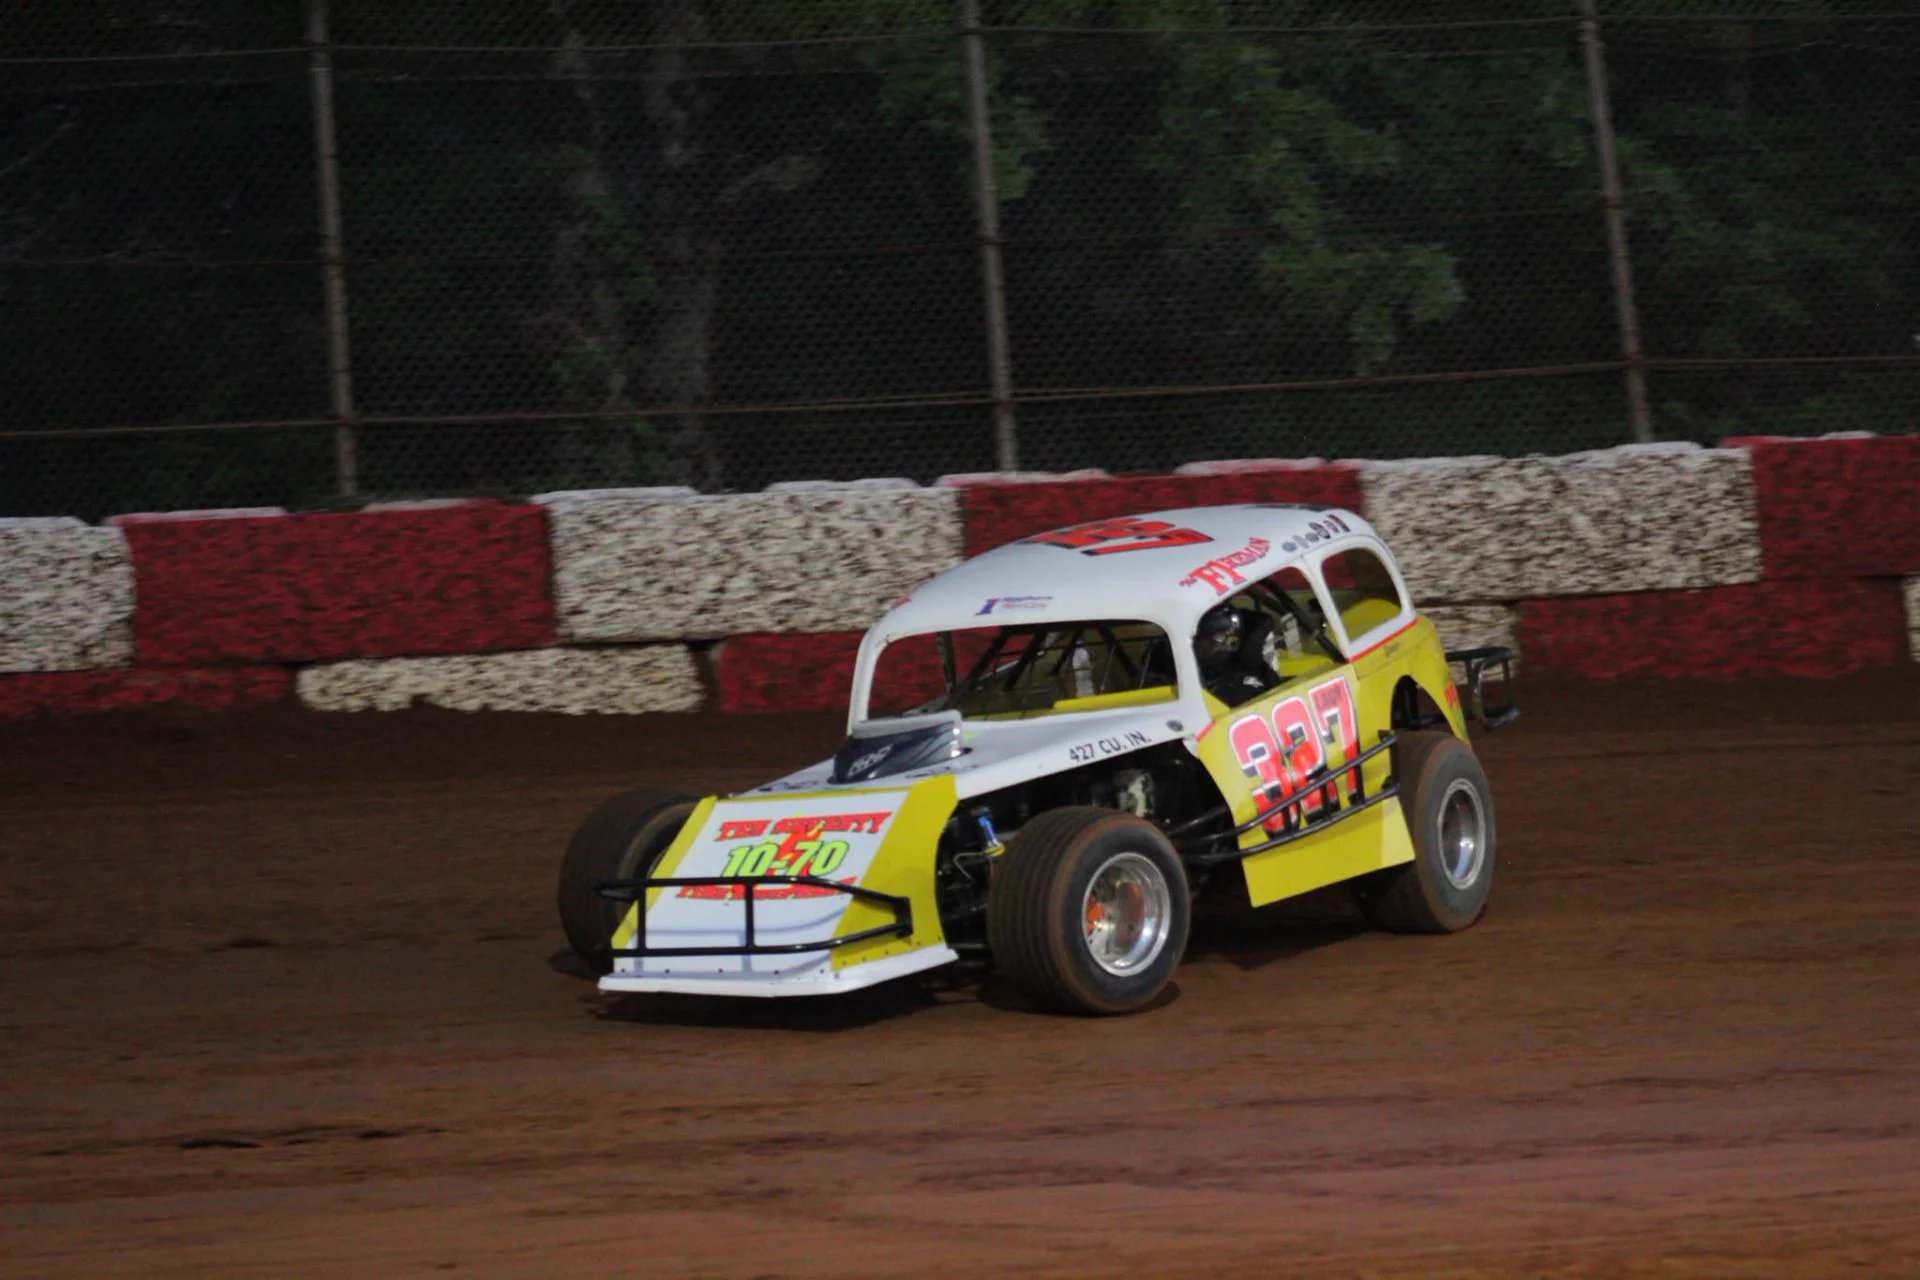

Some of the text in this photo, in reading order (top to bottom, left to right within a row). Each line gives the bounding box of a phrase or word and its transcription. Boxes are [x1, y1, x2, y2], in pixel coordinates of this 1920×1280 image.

[1069, 743, 1095, 762] 427
[1098, 736, 1128, 754] CU.
[1229, 676, 1366, 843] 327
[721, 839, 850, 879] 10-70
